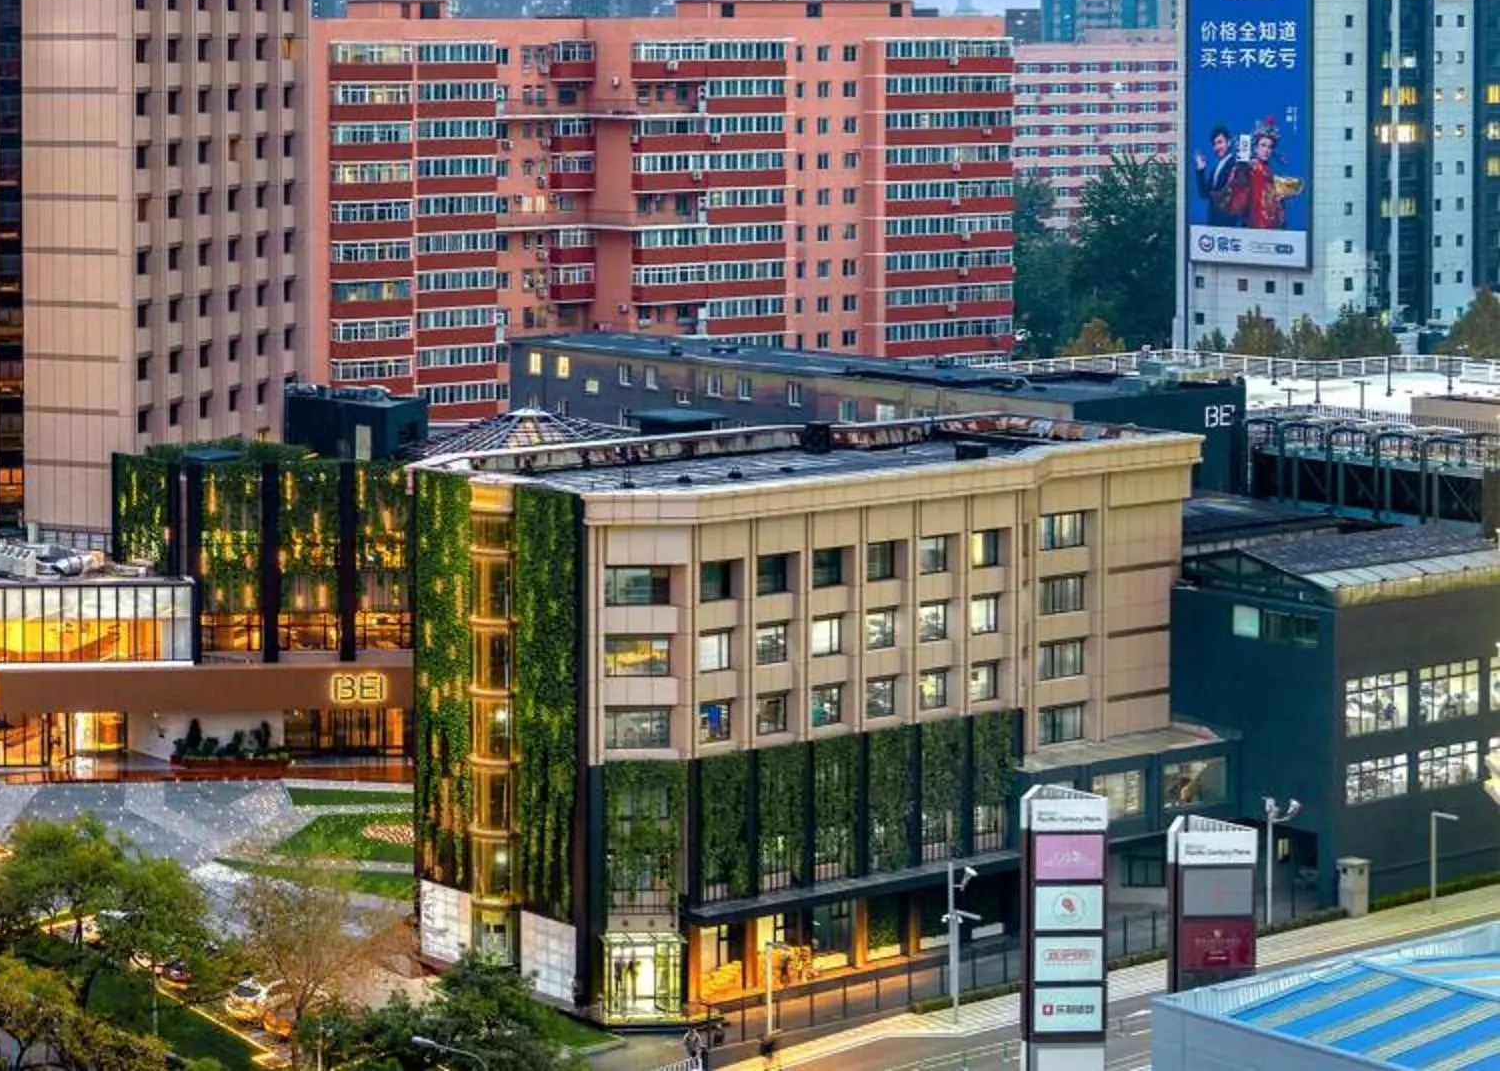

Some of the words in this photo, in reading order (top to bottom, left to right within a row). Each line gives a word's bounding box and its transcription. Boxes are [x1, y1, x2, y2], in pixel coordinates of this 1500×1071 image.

[1199, 20, 1298, 43] 价格全知道
[1199, 47, 1298, 70] 买车不吃亏
